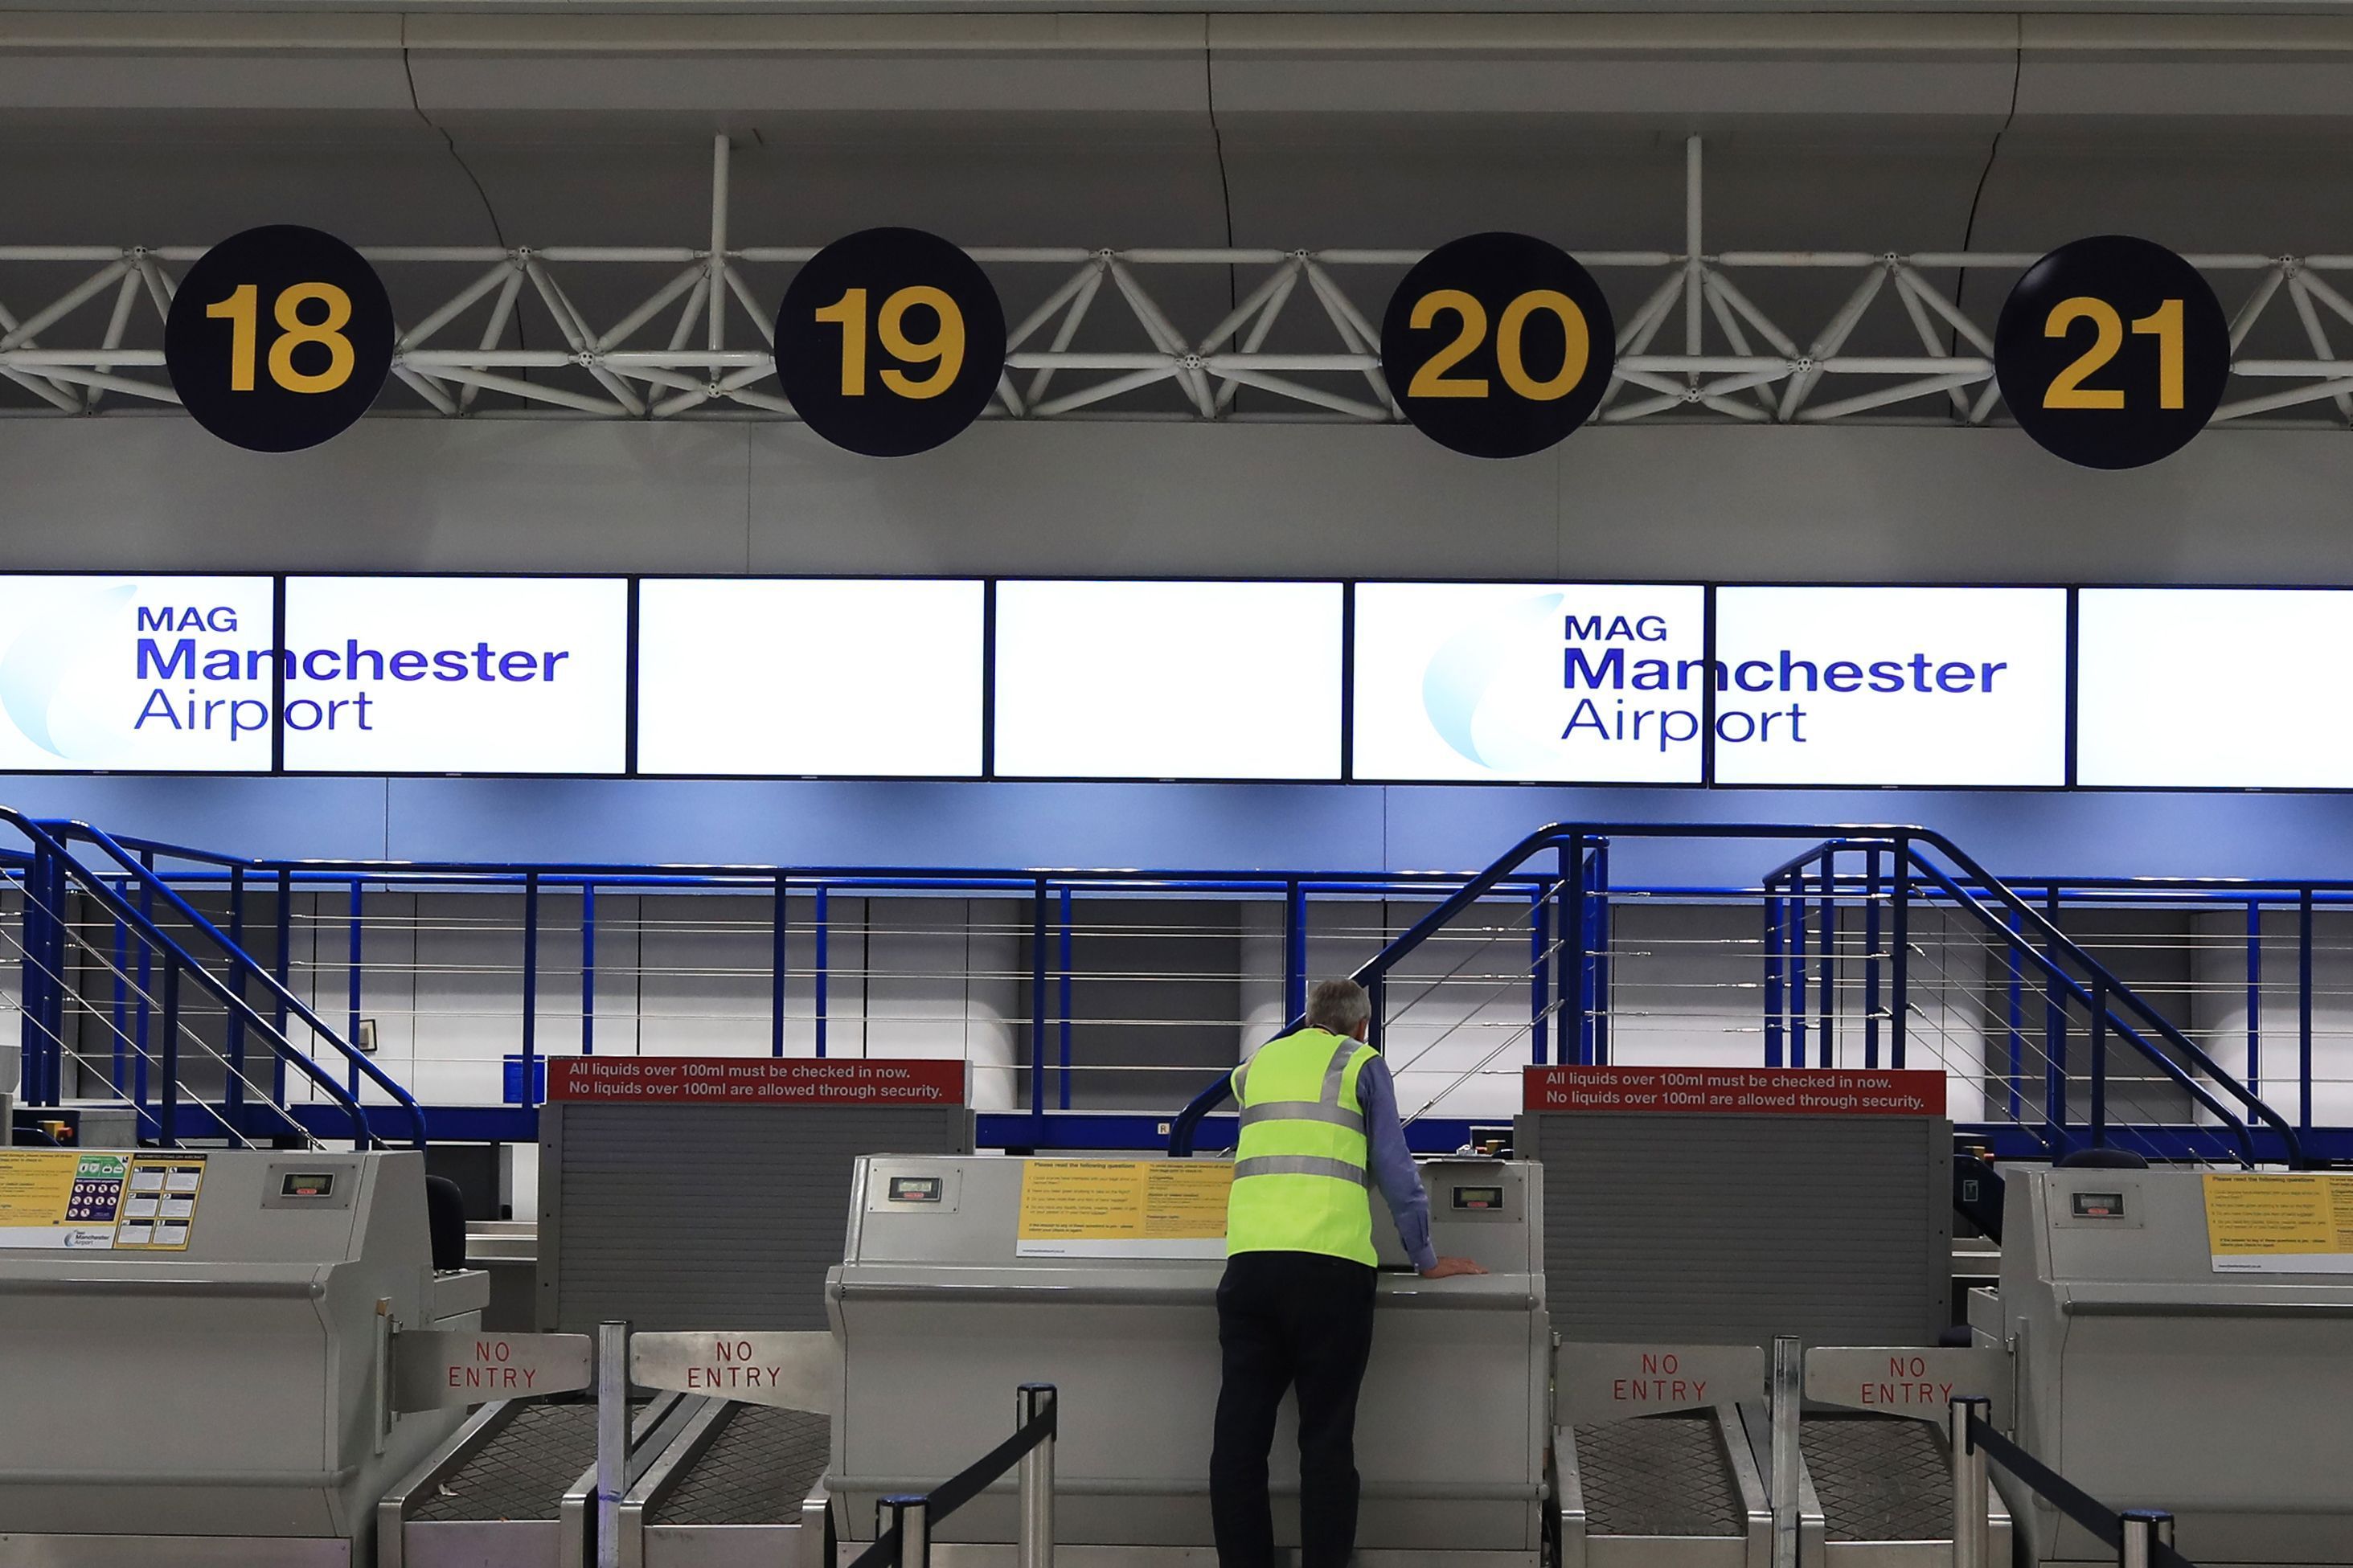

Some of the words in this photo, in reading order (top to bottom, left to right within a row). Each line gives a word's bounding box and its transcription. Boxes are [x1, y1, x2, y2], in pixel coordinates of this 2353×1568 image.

[207, 282, 355, 394] 18
[816, 286, 965, 399] 19
[1408, 289, 1589, 400] 20
[2044, 297, 2184, 409] 21
[137, 606, 238, 633] MAG
[1565, 615, 1667, 642] MAG
[137, 638, 569, 682] Manchester
[1564, 647, 2007, 694] Manchester
[134, 688, 373, 742] Airport
[1562, 698, 1806, 753] Airport
[569, 1062, 588, 1075] All
[592, 1062, 640, 1078] liquids
[644, 1066, 677, 1076] over
[682, 1064, 724, 1076] 100ml
[728, 1065, 765, 1077] must
[769, 1065, 788, 1077] be
[792, 1065, 855, 1078] checked
[859, 1066, 871, 1078] in
[876, 1068, 910, 1078] now.
[1547, 1072, 1564, 1084] All
[1569, 1072, 1617, 1087] liquids
[1622, 1075, 1654, 1085] over
[1660, 1073, 1703, 1086] 100ml
[1707, 1075, 1744, 1087] must
[1749, 1075, 1767, 1087] be
[1772, 1075, 1834, 1088] checked
[1839, 1075, 1852, 1087] in
[1857, 1079, 1892, 1088] now.
[569, 1081, 589, 1094] No
[594, 1081, 642, 1096] liquids
[646, 1085, 678, 1095] over
[683, 1083, 726, 1095] 100ml
[730, 1086, 753, 1095] are
[758, 1083, 814, 1096] allowed
[819, 1083, 876, 1099] through
[880, 1084, 942, 1099] security.
[1547, 1091, 1567, 1103] No
[1572, 1091, 1620, 1106] liquids
[1625, 1094, 1658, 1103] over
[1662, 1092, 1705, 1104] 100ml
[1710, 1095, 1733, 1105] are
[1738, 1093, 1795, 1106] allowed
[1800, 1094, 1857, 1110] through
[1862, 1095, 1924, 1110] security.
[1160, 1125, 1167, 1133] R
[476, 1341, 511, 1362] NO
[715, 1341, 752, 1362] NO
[1642, 1353, 1679, 1375] NO
[1890, 1357, 1925, 1378] NO
[448, 1367, 538, 1389] ENTRY
[687, 1367, 782, 1389] ENTRY
[1613, 1380, 1707, 1402] ENTRY
[1861, 1382, 1953, 1404] ENTRY
